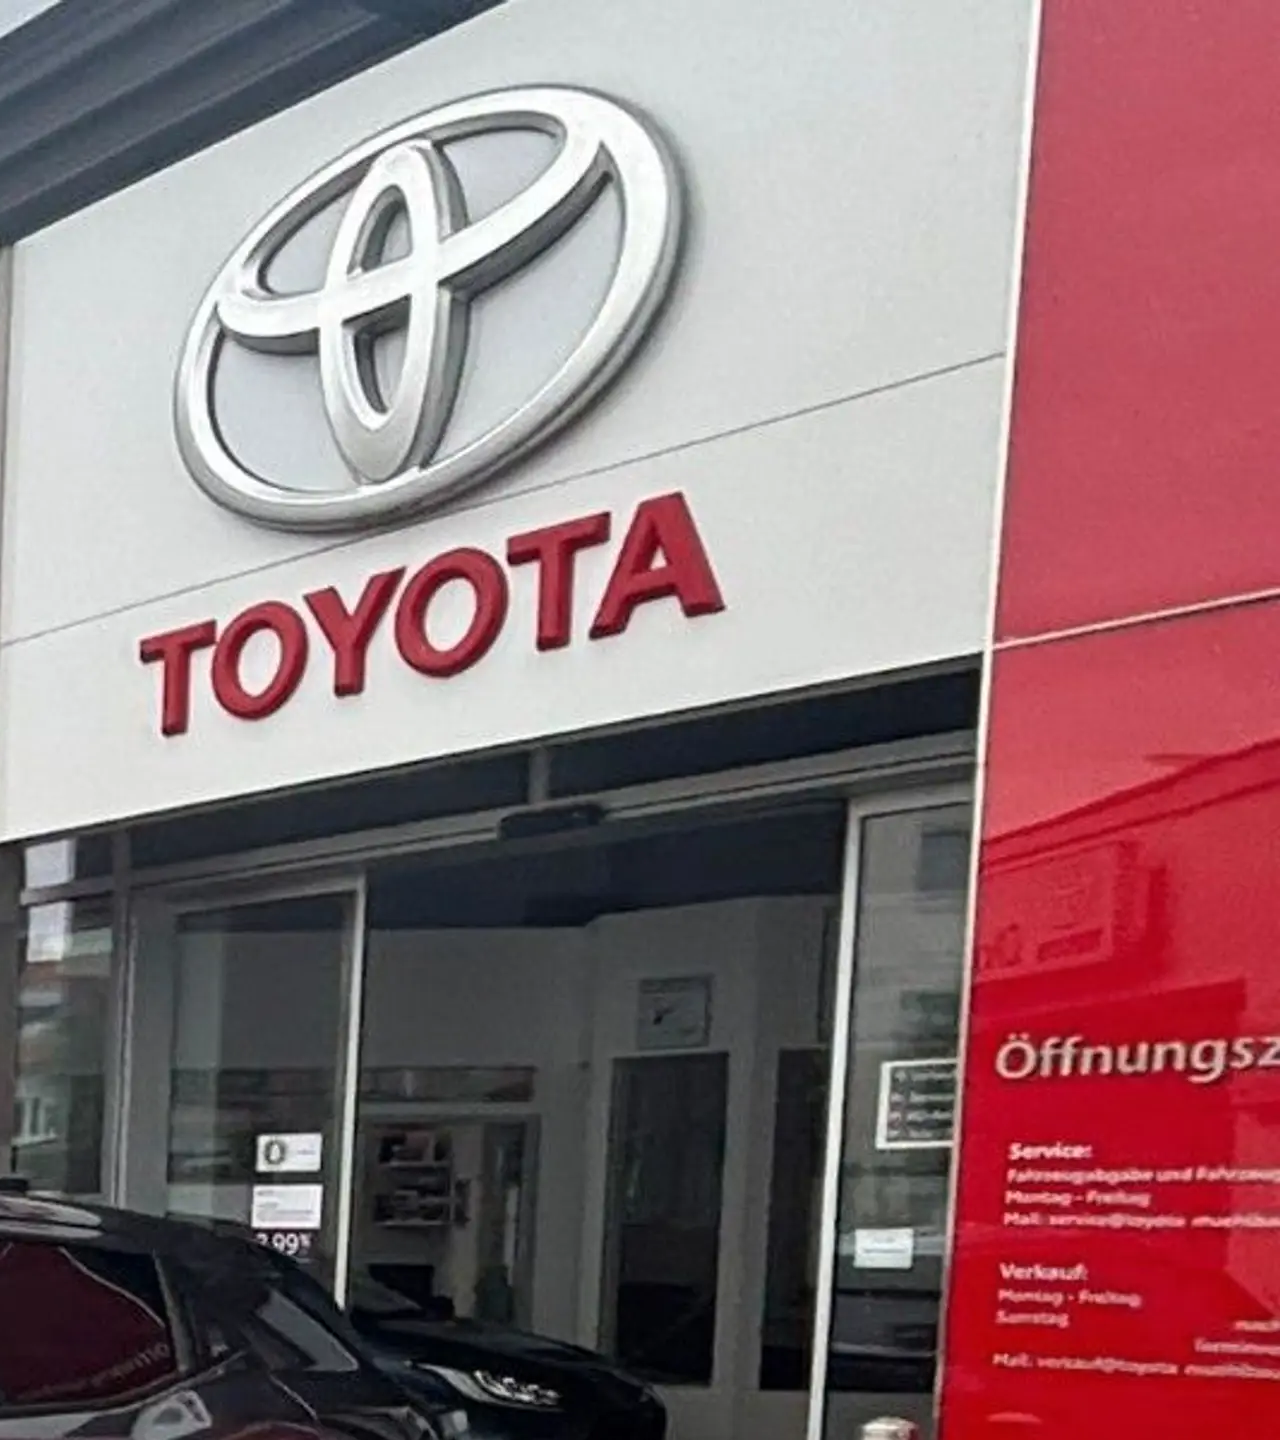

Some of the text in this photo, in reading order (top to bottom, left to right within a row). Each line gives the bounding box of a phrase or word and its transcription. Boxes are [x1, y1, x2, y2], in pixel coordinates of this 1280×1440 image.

[140, 491, 726, 736] TOYOTA
[995, 1032, 1280, 1084] Öffnungsz
[1008, 1142, 1092, 1160] Service:
